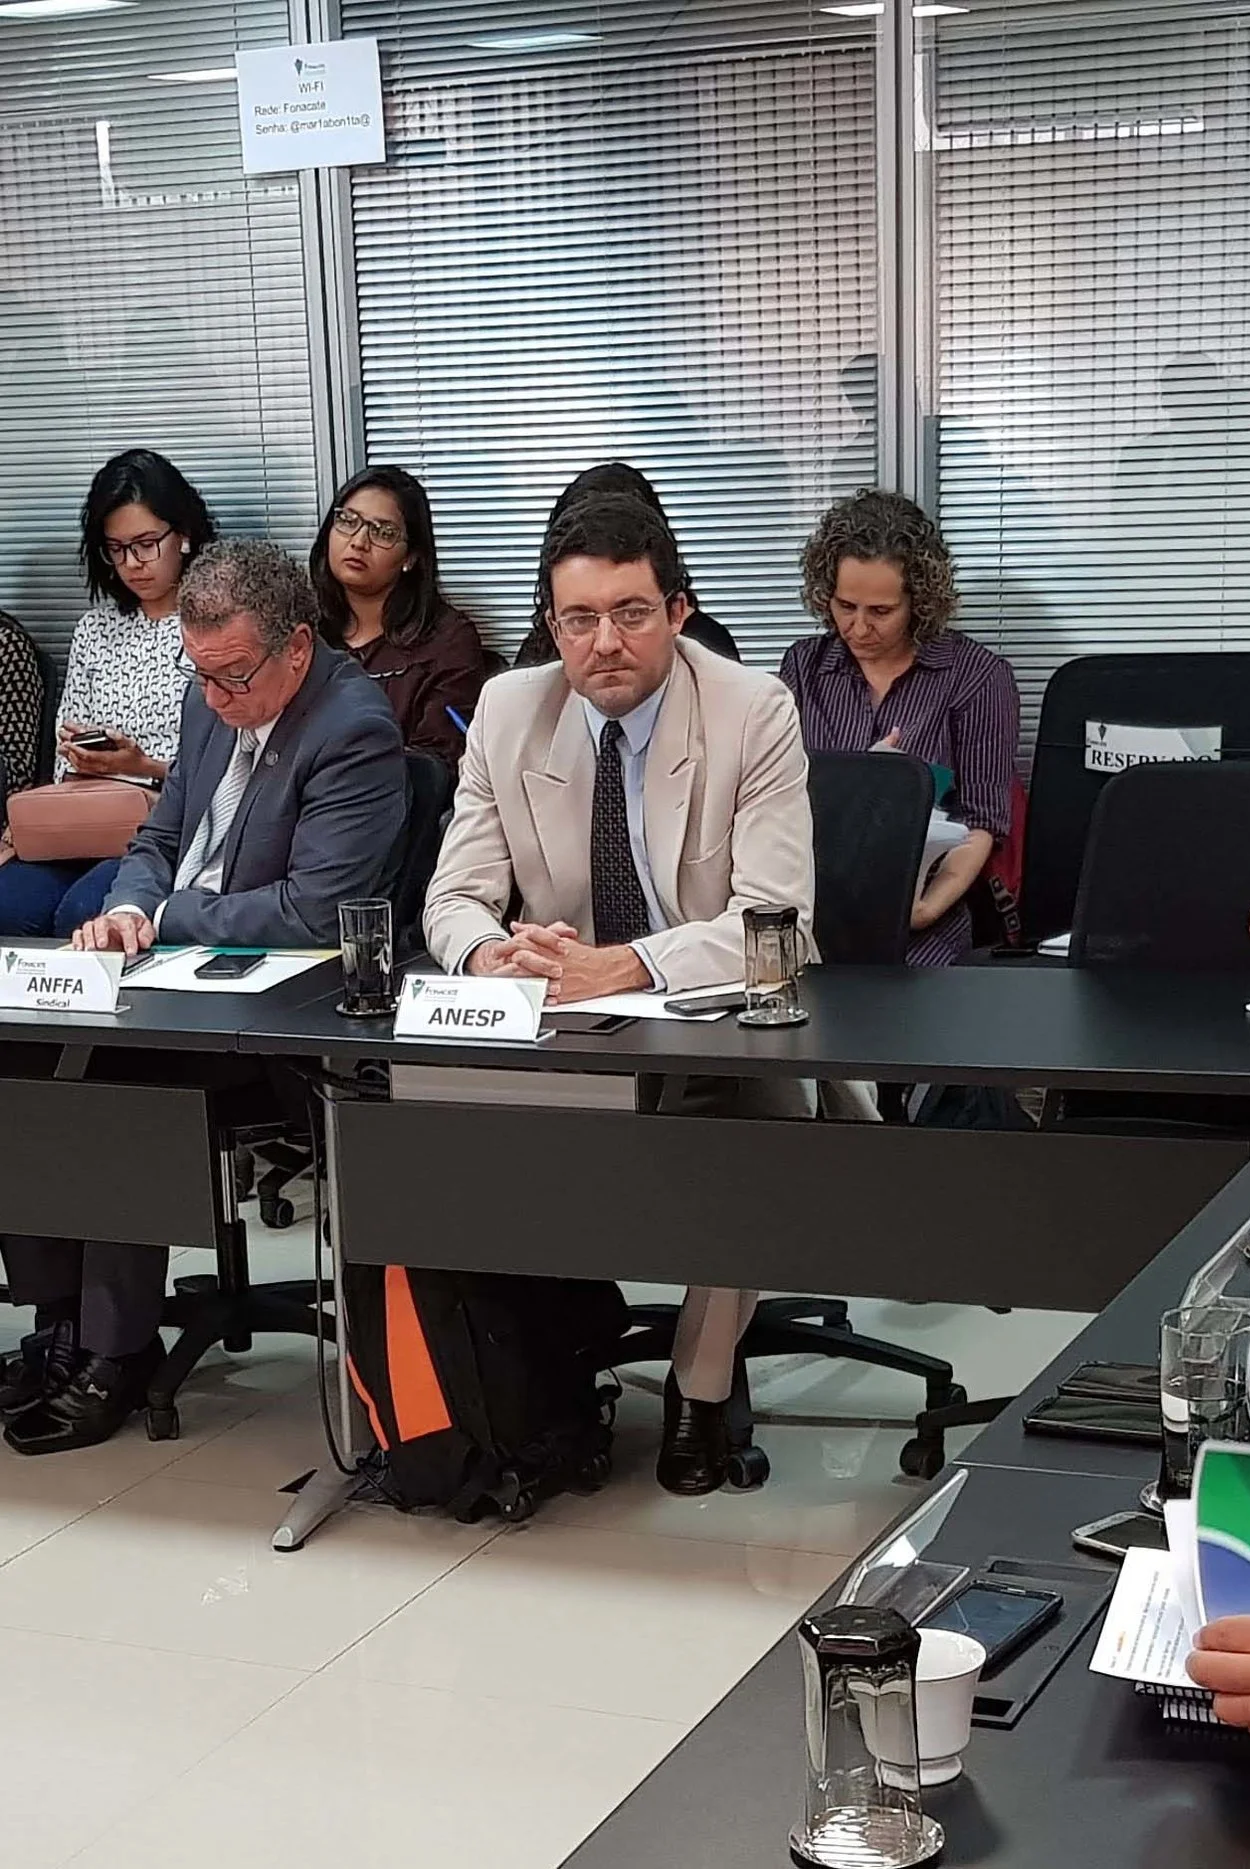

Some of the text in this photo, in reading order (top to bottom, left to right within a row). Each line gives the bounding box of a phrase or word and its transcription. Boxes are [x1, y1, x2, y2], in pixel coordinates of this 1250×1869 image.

[299, 81, 325, 93] WI-FI
[254, 101, 326, 116] Rede: Fonacate
[255, 123, 287, 135] Senha:
[26, 976, 83, 994] ANFFA
[36, 998, 70, 1008] Sindical
[428, 1007, 506, 1027] ANESP
